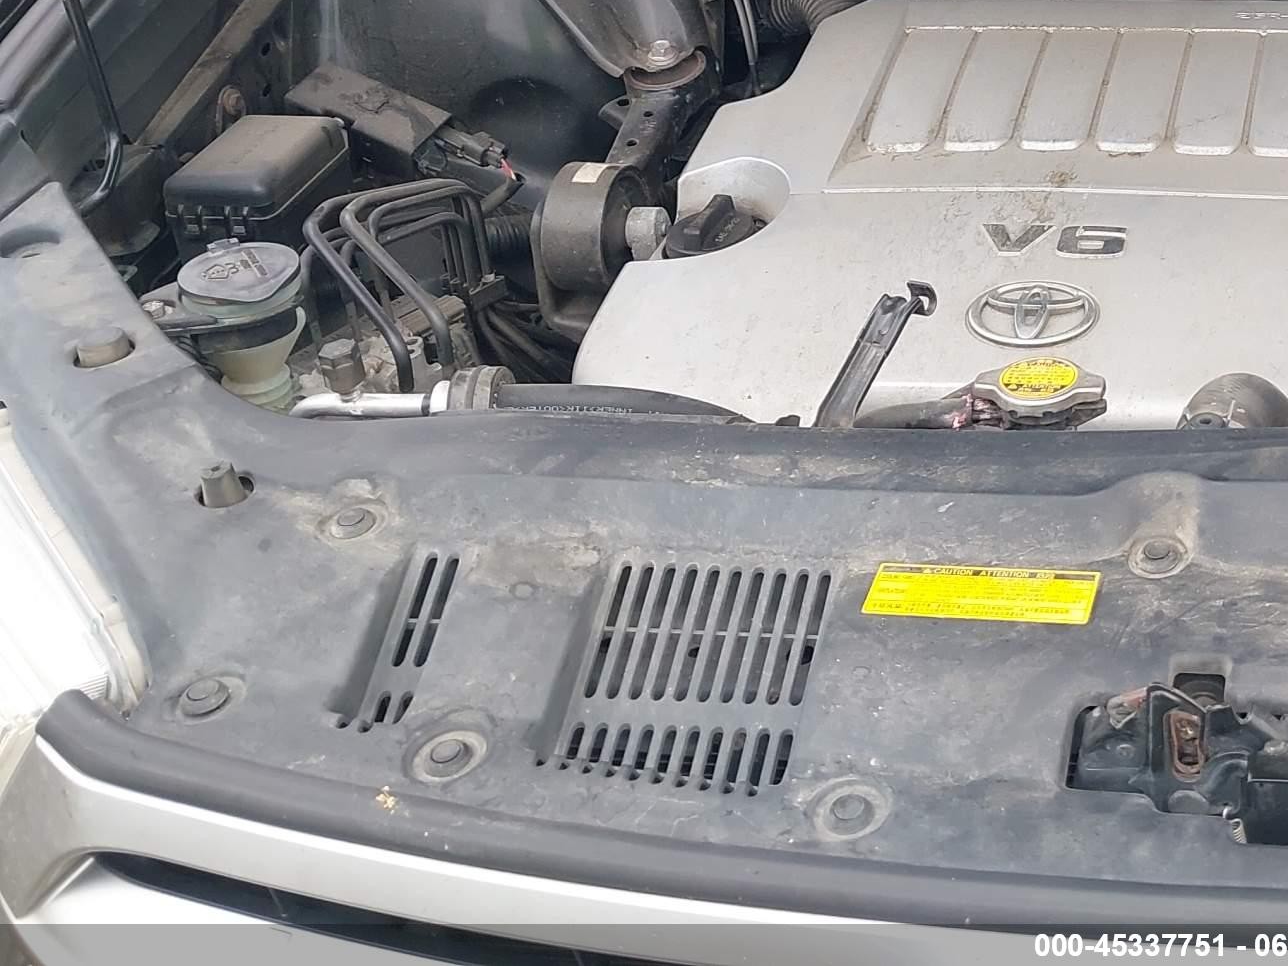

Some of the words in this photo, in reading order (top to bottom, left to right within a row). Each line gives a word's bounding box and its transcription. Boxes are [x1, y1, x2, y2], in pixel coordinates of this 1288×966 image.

[982, 222, 1129, 260] V6
[934, 568, 974, 576] CAUTION
[979, 569, 1030, 578] ATTENTION
